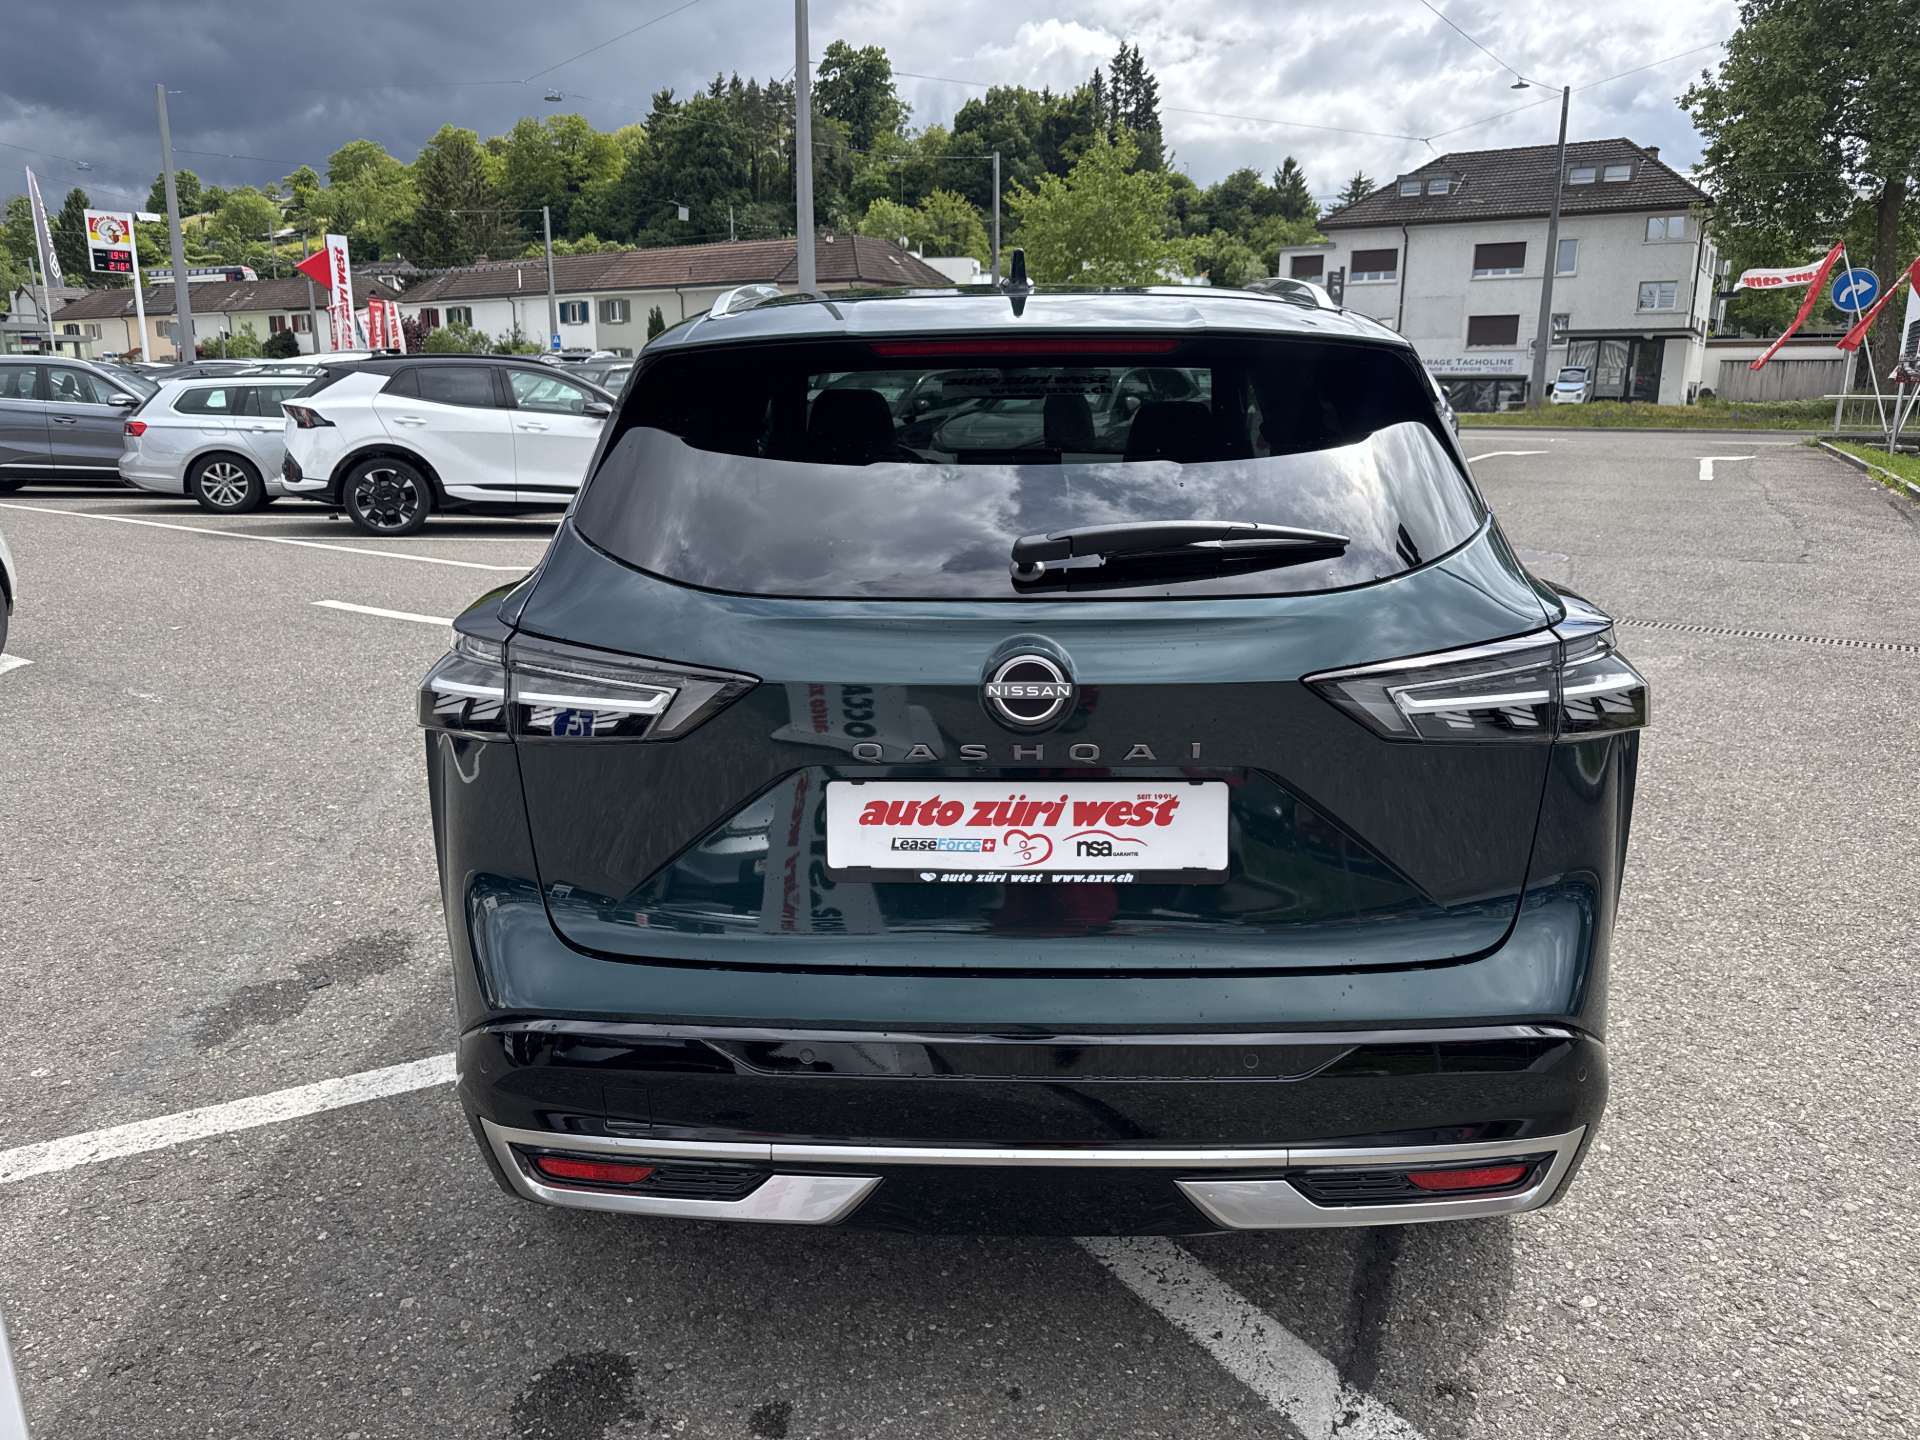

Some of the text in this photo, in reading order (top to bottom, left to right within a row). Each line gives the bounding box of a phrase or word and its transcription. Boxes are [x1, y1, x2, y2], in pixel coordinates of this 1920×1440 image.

[334, 246, 347, 284] west
[1456, 358, 1514, 366] TACHOLINE
[988, 685, 1070, 696] NISSAN
[852, 742, 1201, 765] QASHQAI
[859, 794, 1180, 827] auto züri west
[891, 837, 982, 851] LeaseForce
[1076, 840, 1112, 857] nsa
[941, 872, 1134, 883] auto züri west www.azw.ch
